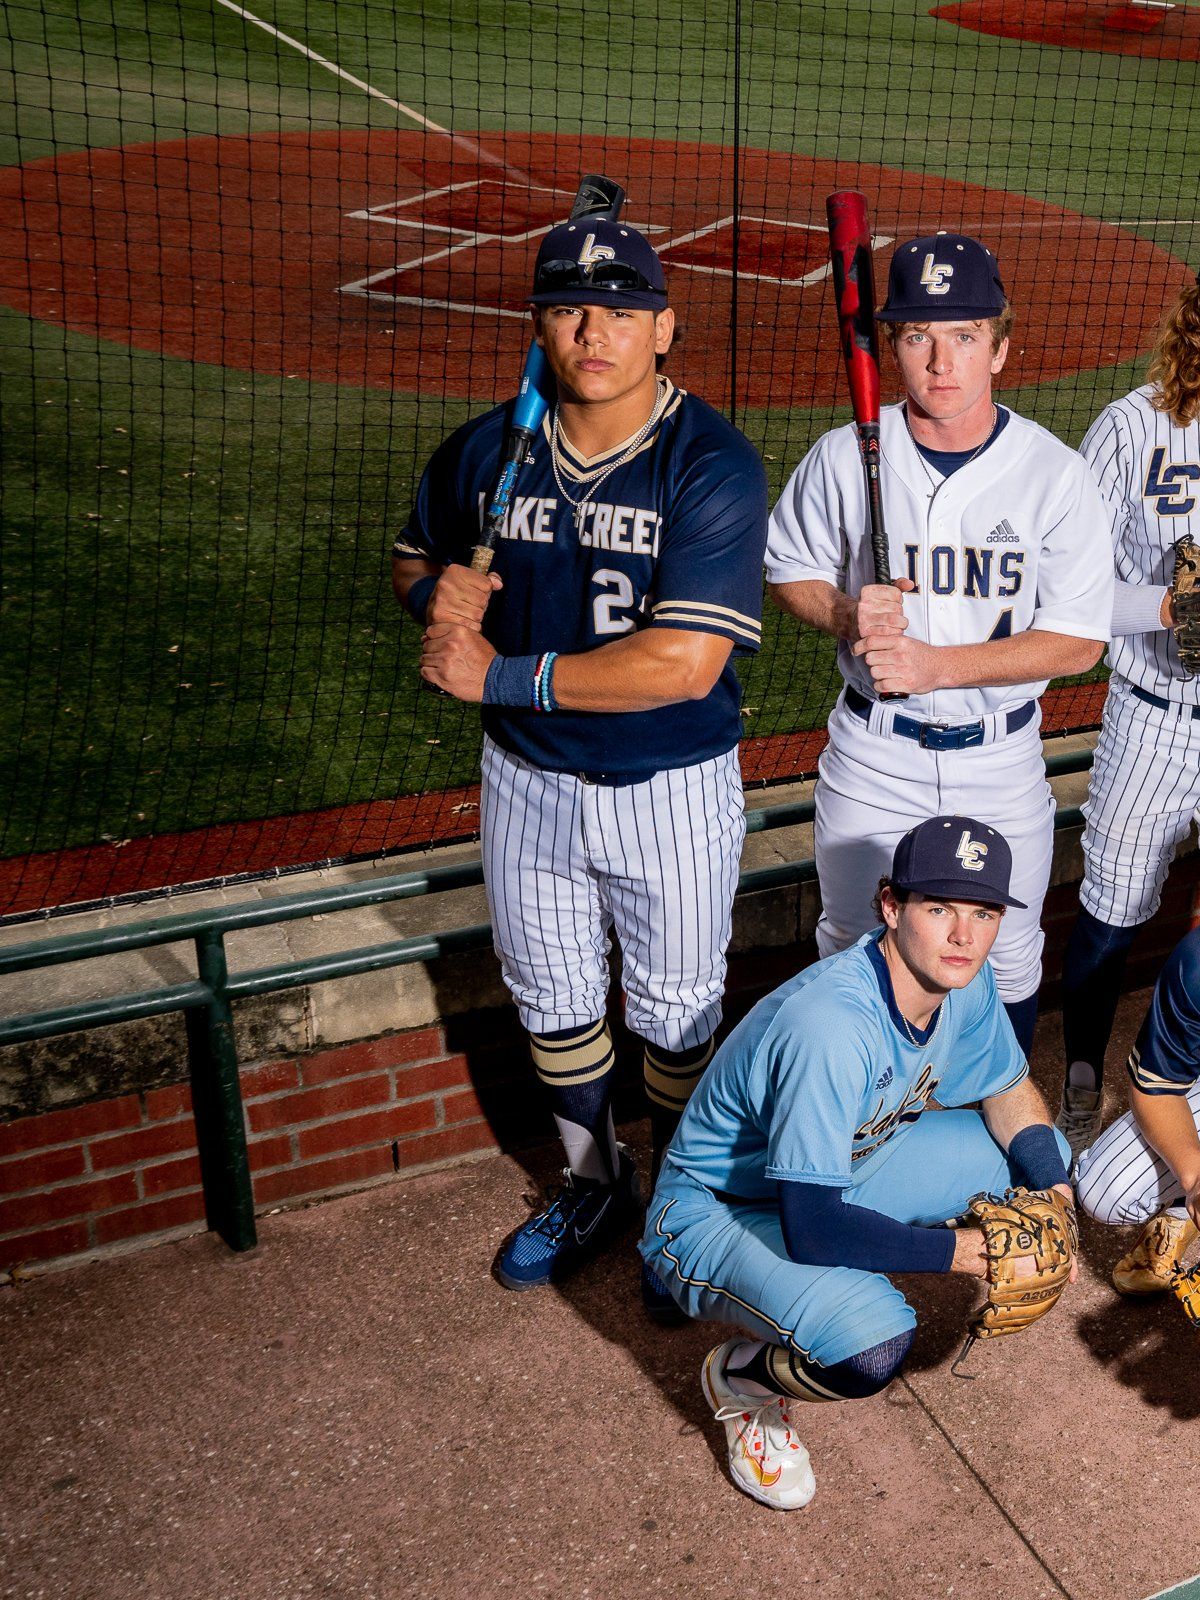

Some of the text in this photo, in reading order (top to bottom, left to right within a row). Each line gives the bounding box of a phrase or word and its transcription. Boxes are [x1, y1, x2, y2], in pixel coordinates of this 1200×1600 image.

[919, 253, 954, 295] LC
[986, 533, 1020, 544] adidas
[903, 543, 1025, 597] IONS
[955, 830, 989, 871] LC
